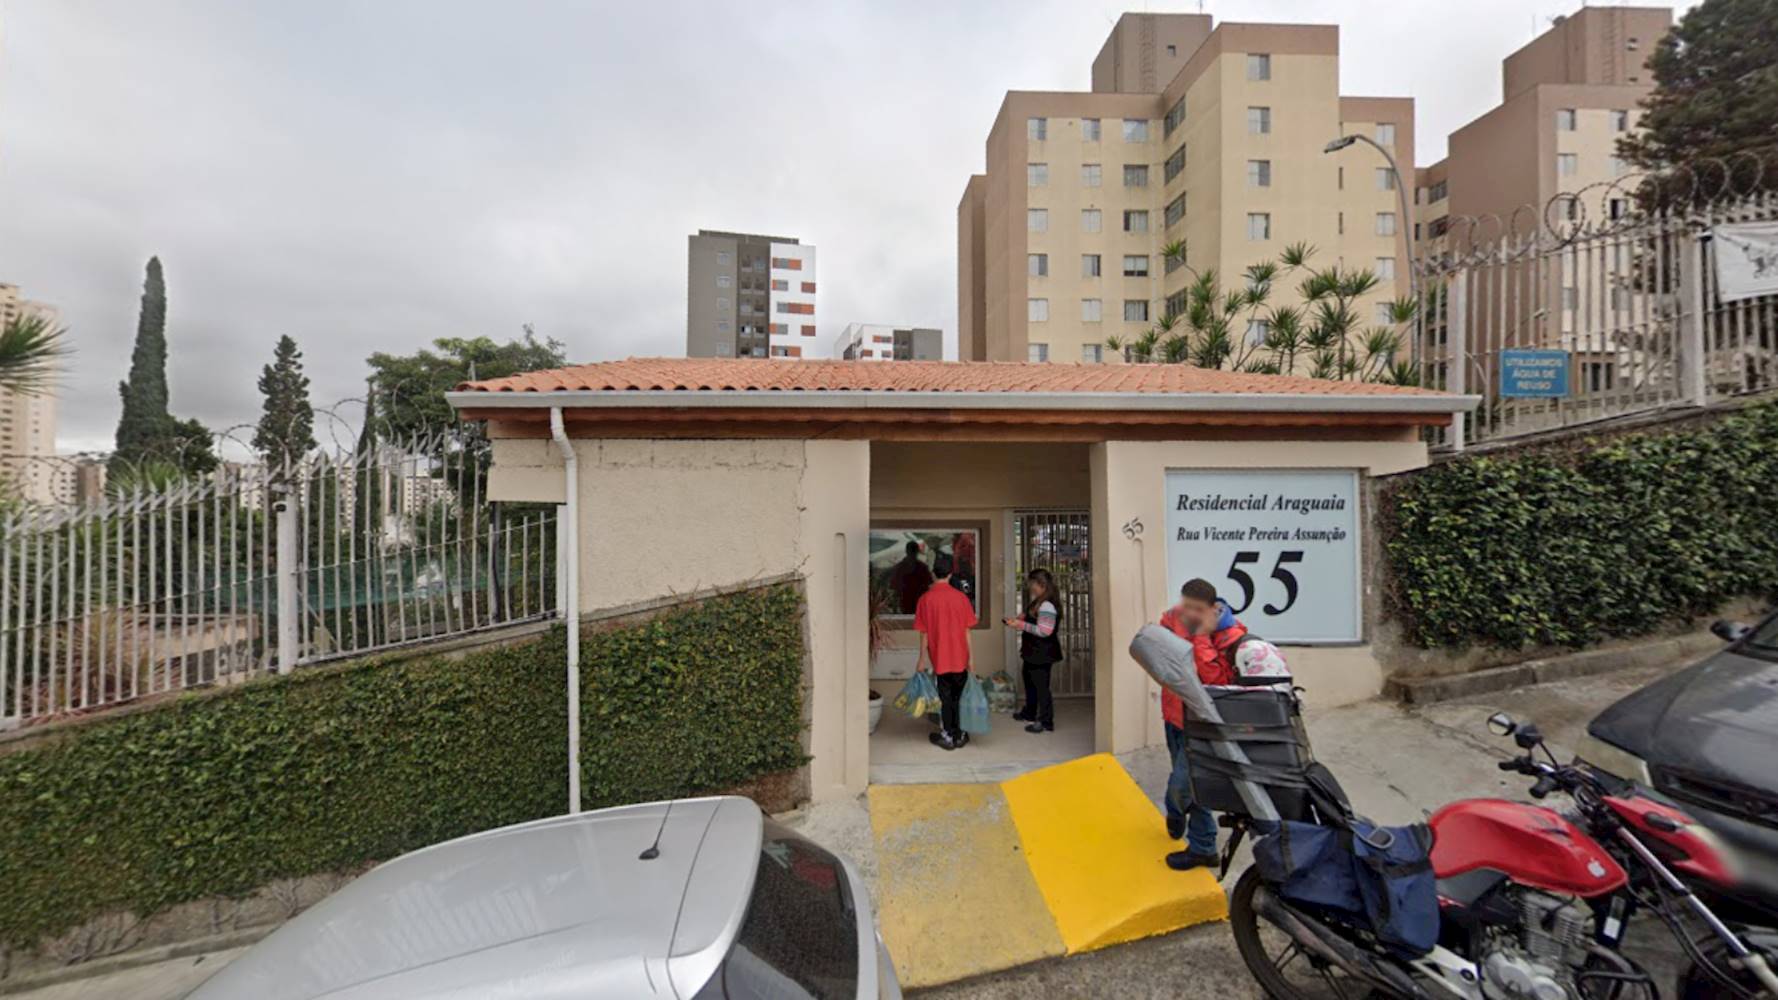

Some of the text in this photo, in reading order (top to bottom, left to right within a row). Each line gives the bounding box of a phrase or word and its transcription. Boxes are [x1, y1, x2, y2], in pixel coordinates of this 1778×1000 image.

[1176, 493, 1345, 515] Residencial Araguaia
[1121, 517, 1144, 540] 55
[1177, 526, 1347, 543] Rua Vicente Pereira Assunção
[1226, 551, 1304, 616] 55
